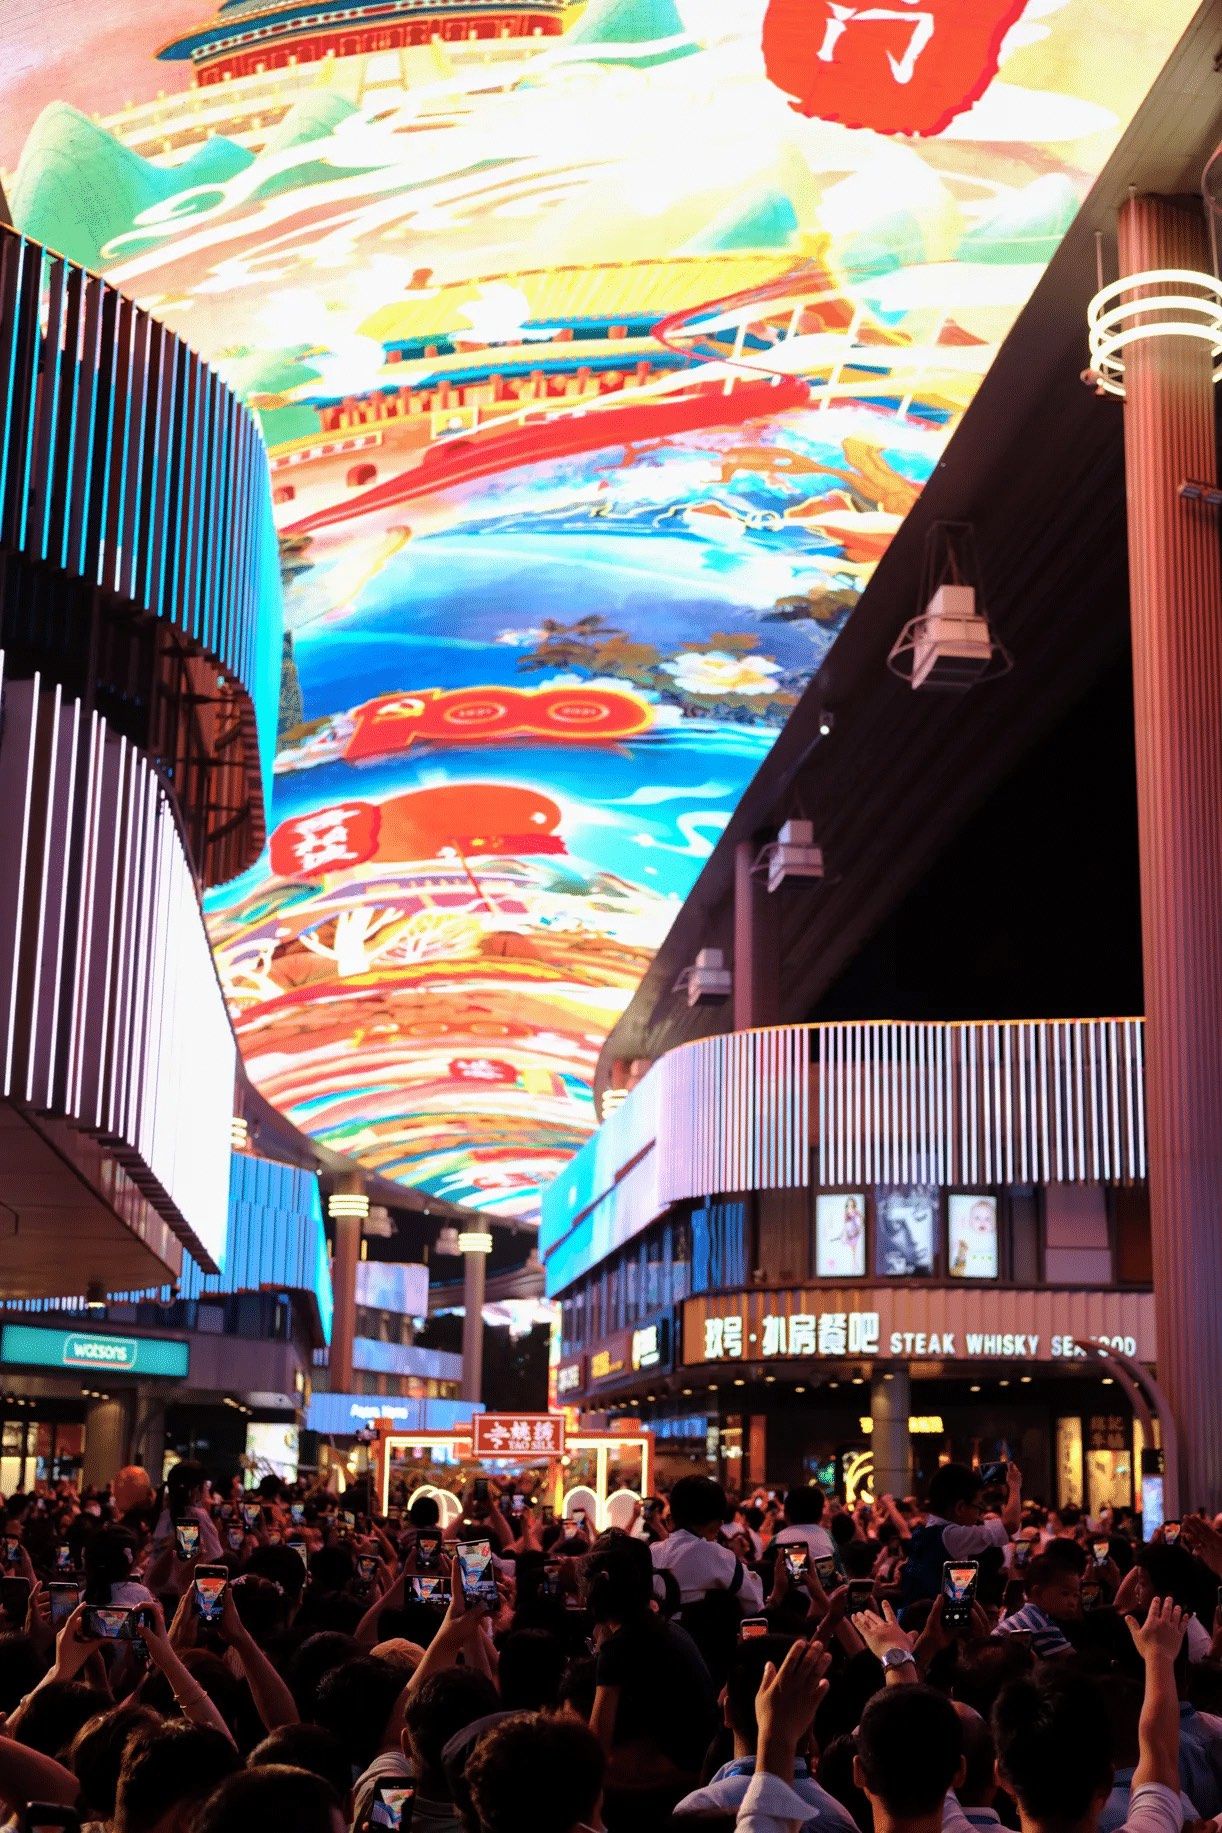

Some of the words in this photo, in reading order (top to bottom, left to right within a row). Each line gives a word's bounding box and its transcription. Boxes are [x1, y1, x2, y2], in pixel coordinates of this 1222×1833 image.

[74, 1342, 127, 1361] watsons
[890, 1332, 955, 1355] STEAK
[965, 1334, 1039, 1357] WHISKY
